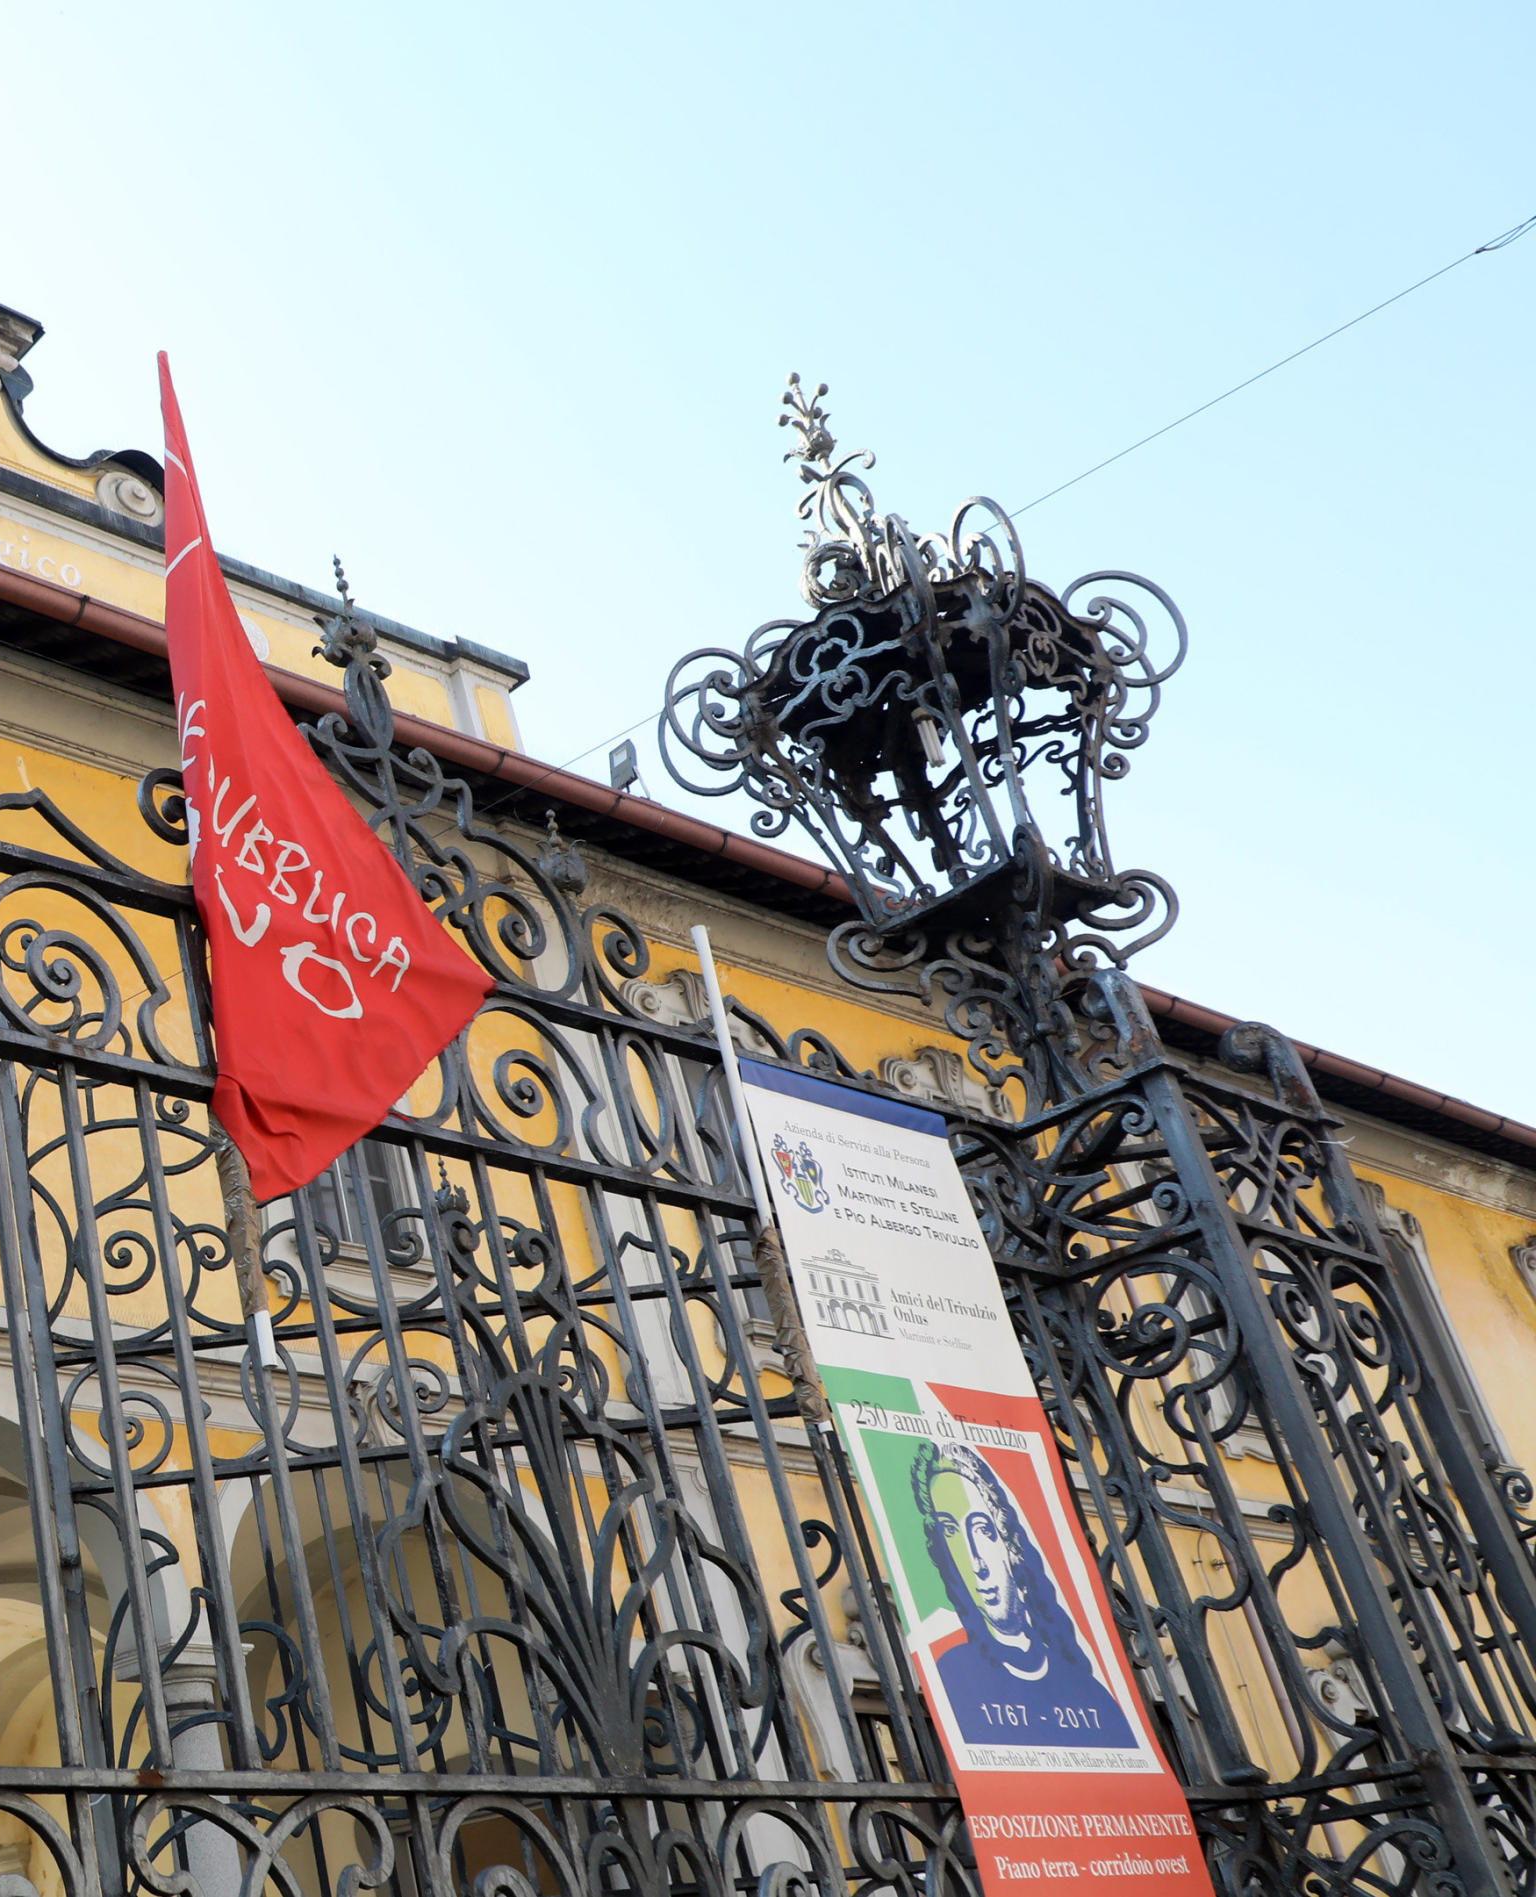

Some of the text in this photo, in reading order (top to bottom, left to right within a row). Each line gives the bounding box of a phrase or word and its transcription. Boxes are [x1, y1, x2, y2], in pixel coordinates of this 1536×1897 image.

[208, 754, 410, 992] UBBLICA
[783, 1121, 931, 1168] Azienda di Servizi alla Persona
[842, 1163, 938, 1198] ISTITUTI MILANESI
[837, 1184, 897, 1210] MARTINITT
[910, 1202, 959, 1224] STELLINE
[845, 1208, 866, 1224] PIO
[870, 1215, 922, 1237] ALBERGO
[923, 1226, 980, 1250] TRIVULZIO
[890, 1288, 998, 1321] Amici del Trivulzio
[893, 1305, 929, 1326] Onlus
[851, 1399, 1028, 1450] 250 anni di Trivulzio
[980, 1703, 1029, 1726] 1767
[1054, 1706, 1101, 1729] 2017
[1025, 1751, 1040, 1767] del
[1069, 1753, 1105, 1769] Welfare
[1106, 1753, 1121, 1769] del
[1117, 1753, 1150, 1769] Futuro
[969, 1813, 1192, 1839] ESPOSIZIONE PERMANENTE
[994, 1855, 1041, 1880] Piano
[1040, 1857, 1080, 1879] terra
[1089, 1852, 1154, 1877] corridoio
[1155, 1854, 1191, 1876] ovest
